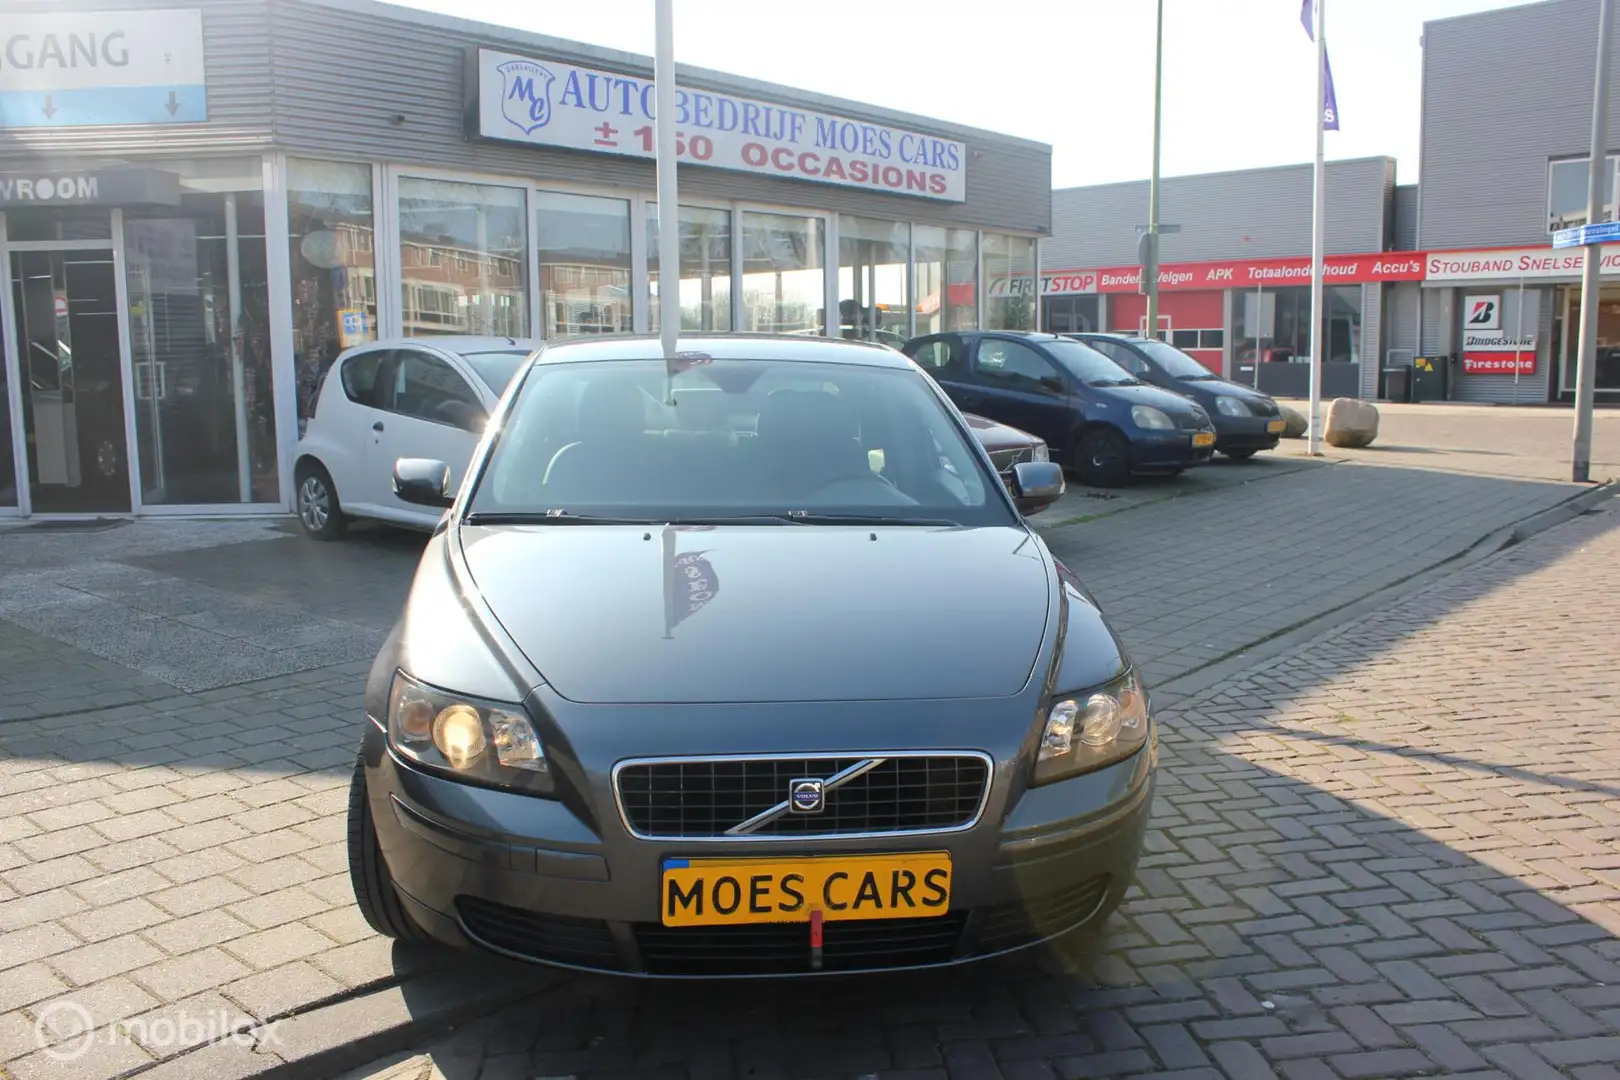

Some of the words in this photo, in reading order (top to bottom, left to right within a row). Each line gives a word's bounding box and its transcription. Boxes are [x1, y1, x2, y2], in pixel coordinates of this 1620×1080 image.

[0, 31, 130, 70] GANG
[815, 116, 892, 160] MOES
[898, 134, 959, 172] CARS
[741, 142, 948, 195] OCCASIONS
[1206, 268, 1234, 281] APK
[1248, 262, 1359, 279] Totaalondehoud
[1371, 259, 1421, 275] Accu's
[1429, 258, 1514, 275] STOUBAND
[1518, 253, 1620, 272] SNELSEIC
[1009, 275, 1094, 294] FIRTSTOP
[795, 792, 819, 800] VOLVO
[667, 874, 806, 917] MOES
[822, 868, 949, 911] CARS
